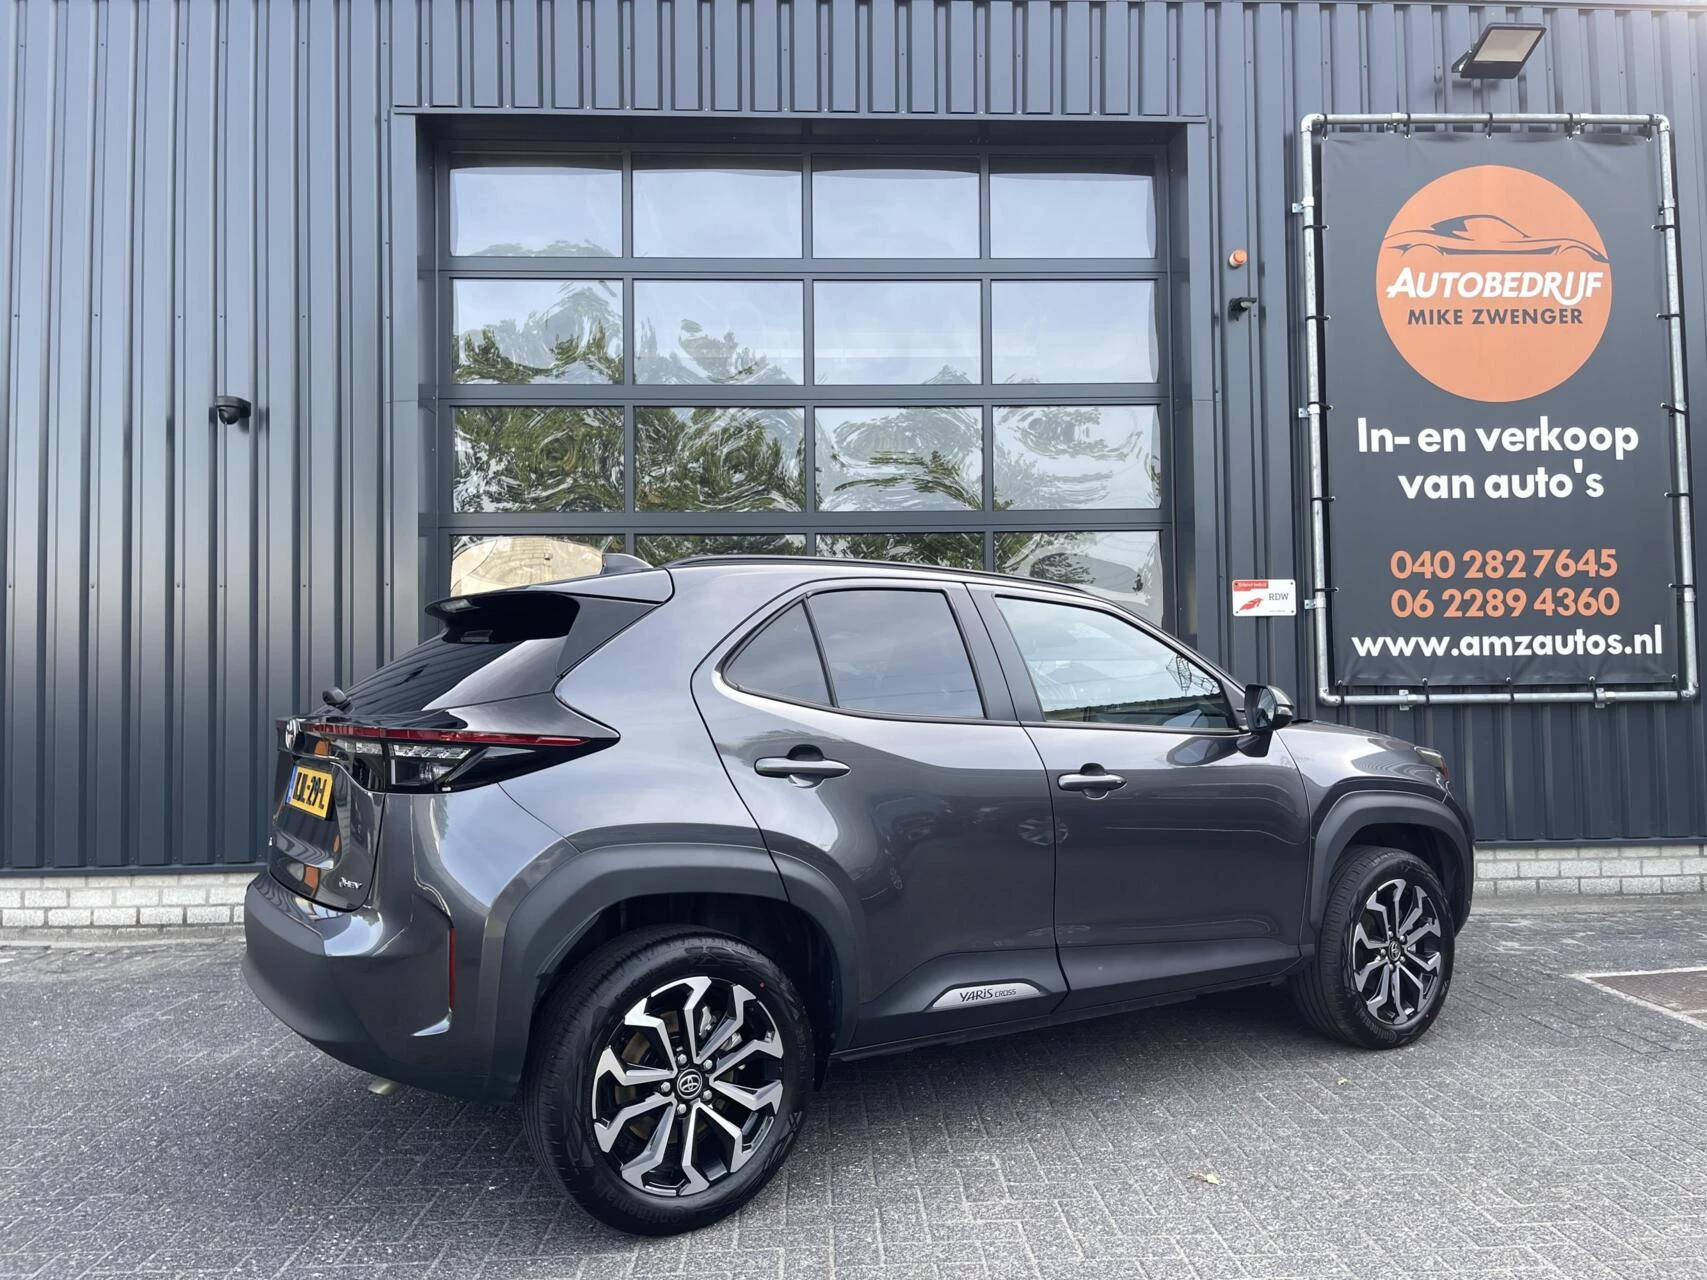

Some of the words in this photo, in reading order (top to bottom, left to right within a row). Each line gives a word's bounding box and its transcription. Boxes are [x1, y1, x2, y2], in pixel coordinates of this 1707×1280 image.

[1407, 309, 1463, 325] MIKE
[1472, 308, 1583, 324] ZWENGER
[1357, 417, 1410, 452] In-
[1417, 428, 1466, 452] en
[1475, 415, 1639, 460] verkoop
[1397, 473, 1475, 499] van
[1484, 458, 1605, 498] auto's
[1390, 550, 1456, 579] 040
[1462, 550, 1527, 578] 282
[1532, 549, 1618, 578] 7645
[1390, 589, 1435, 618] 06
[1441, 588, 1527, 618] 2289
[1533, 587, 1620, 616] 4360
[1351, 624, 1663, 657] www.amzautos.nl
[994, 989, 1017, 998] CROSS
